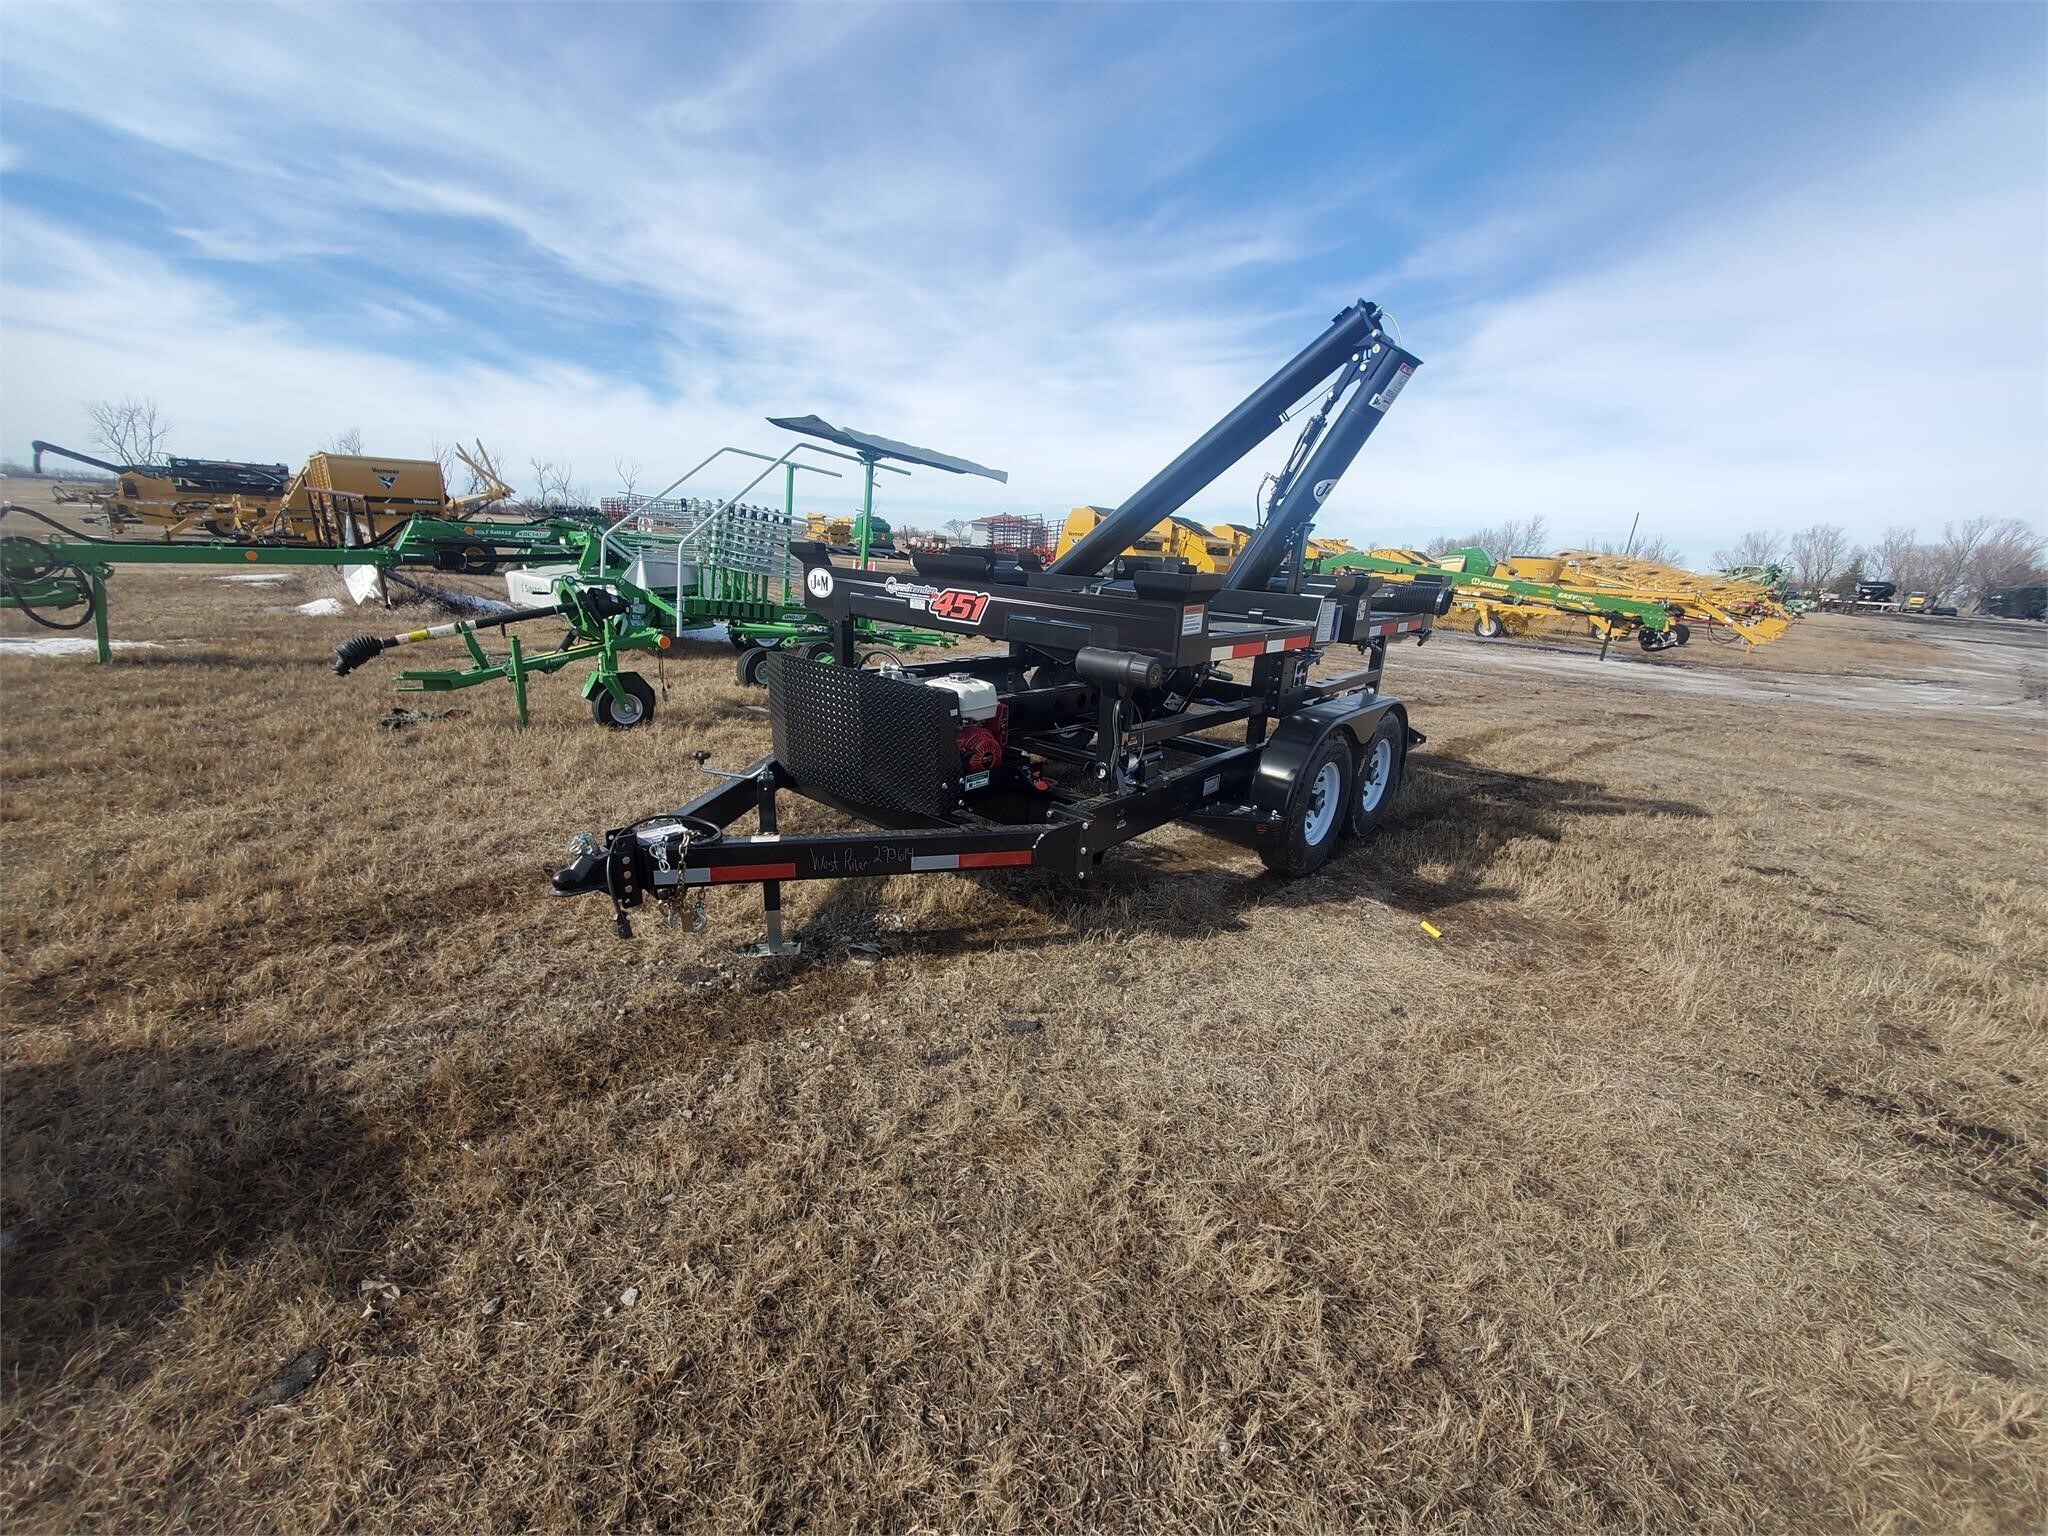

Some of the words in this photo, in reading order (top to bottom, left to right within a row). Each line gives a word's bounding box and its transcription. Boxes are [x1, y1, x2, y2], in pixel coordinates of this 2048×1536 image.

[372, 466, 399, 474] Vermeer
[810, 574, 828, 591] J&M
[1479, 581, 1509, 590] KRONE
[930, 591, 988, 622] 451
[810, 847, 840, 872] West
